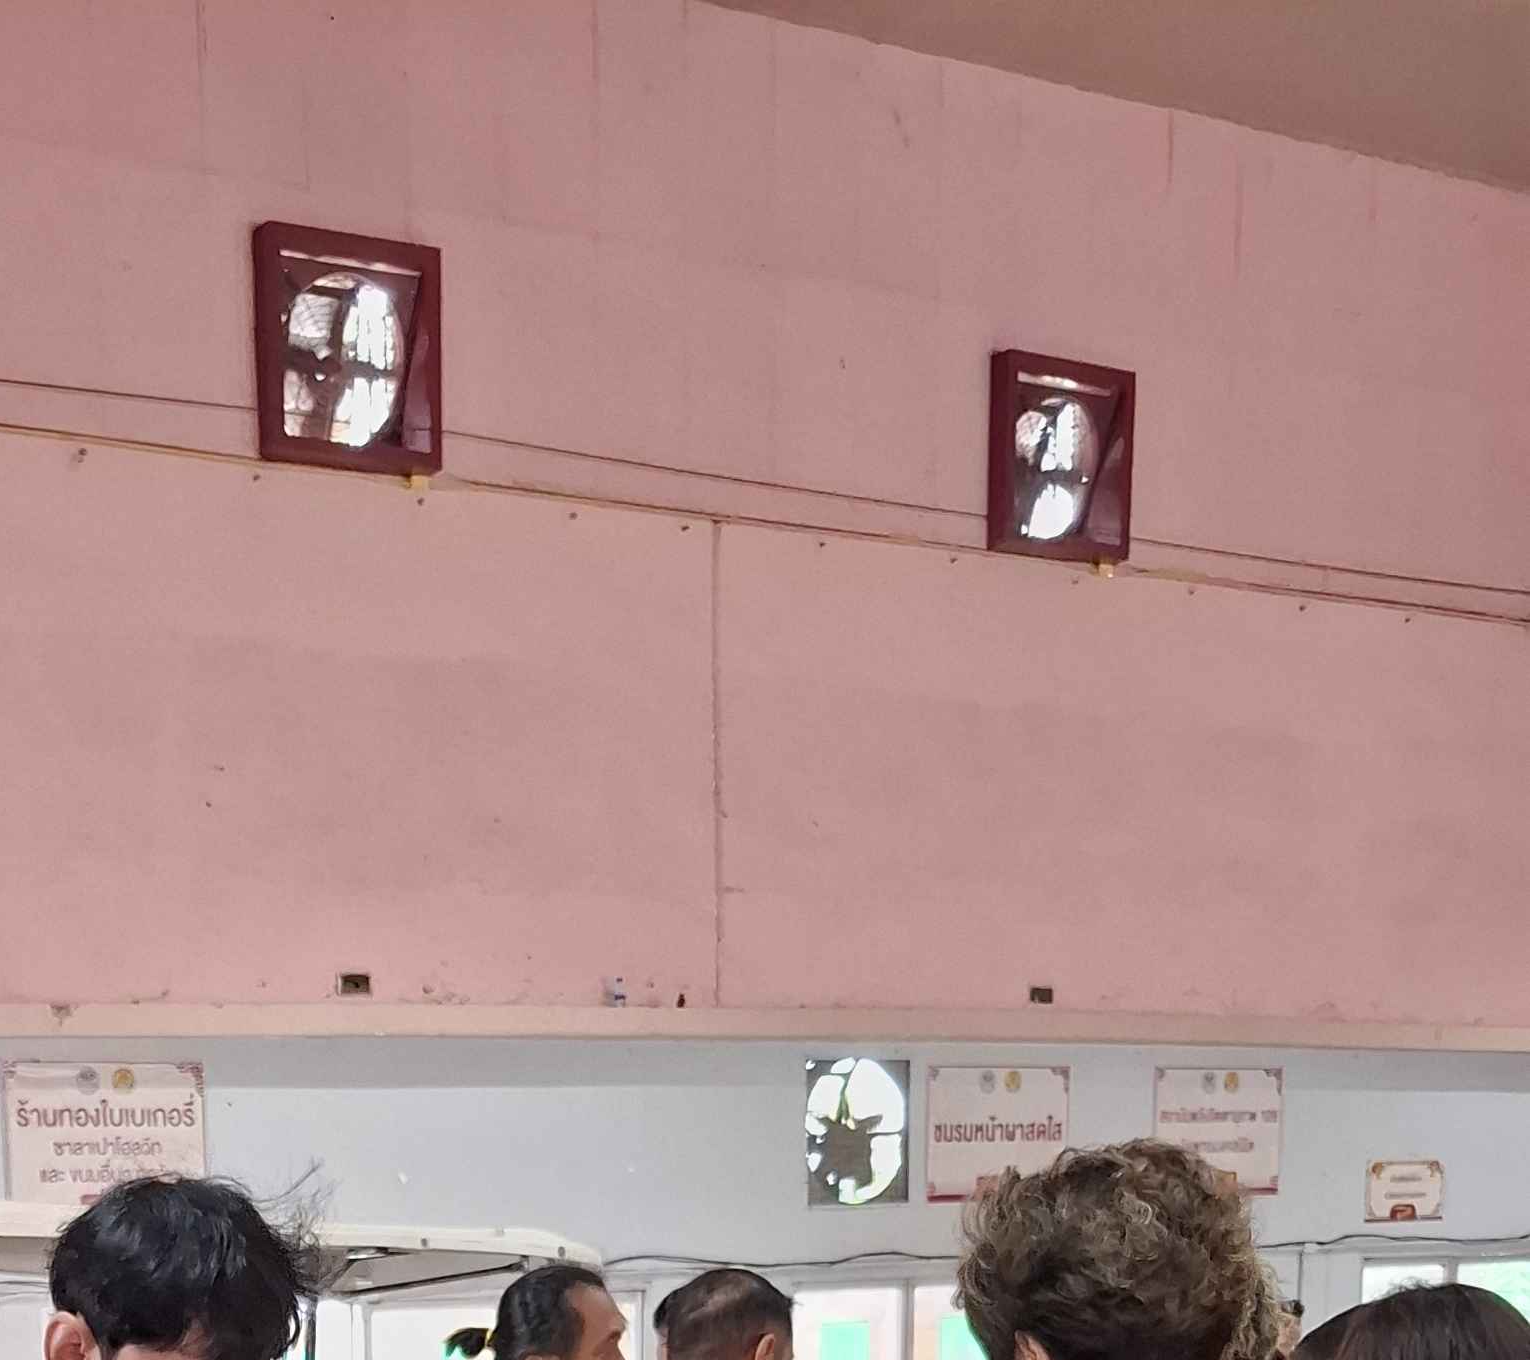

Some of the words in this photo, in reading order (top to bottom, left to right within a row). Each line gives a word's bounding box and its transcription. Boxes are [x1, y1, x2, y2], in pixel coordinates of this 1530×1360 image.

[16, 1093, 196, 1128] ร้านทองใบเบเกอรี่
